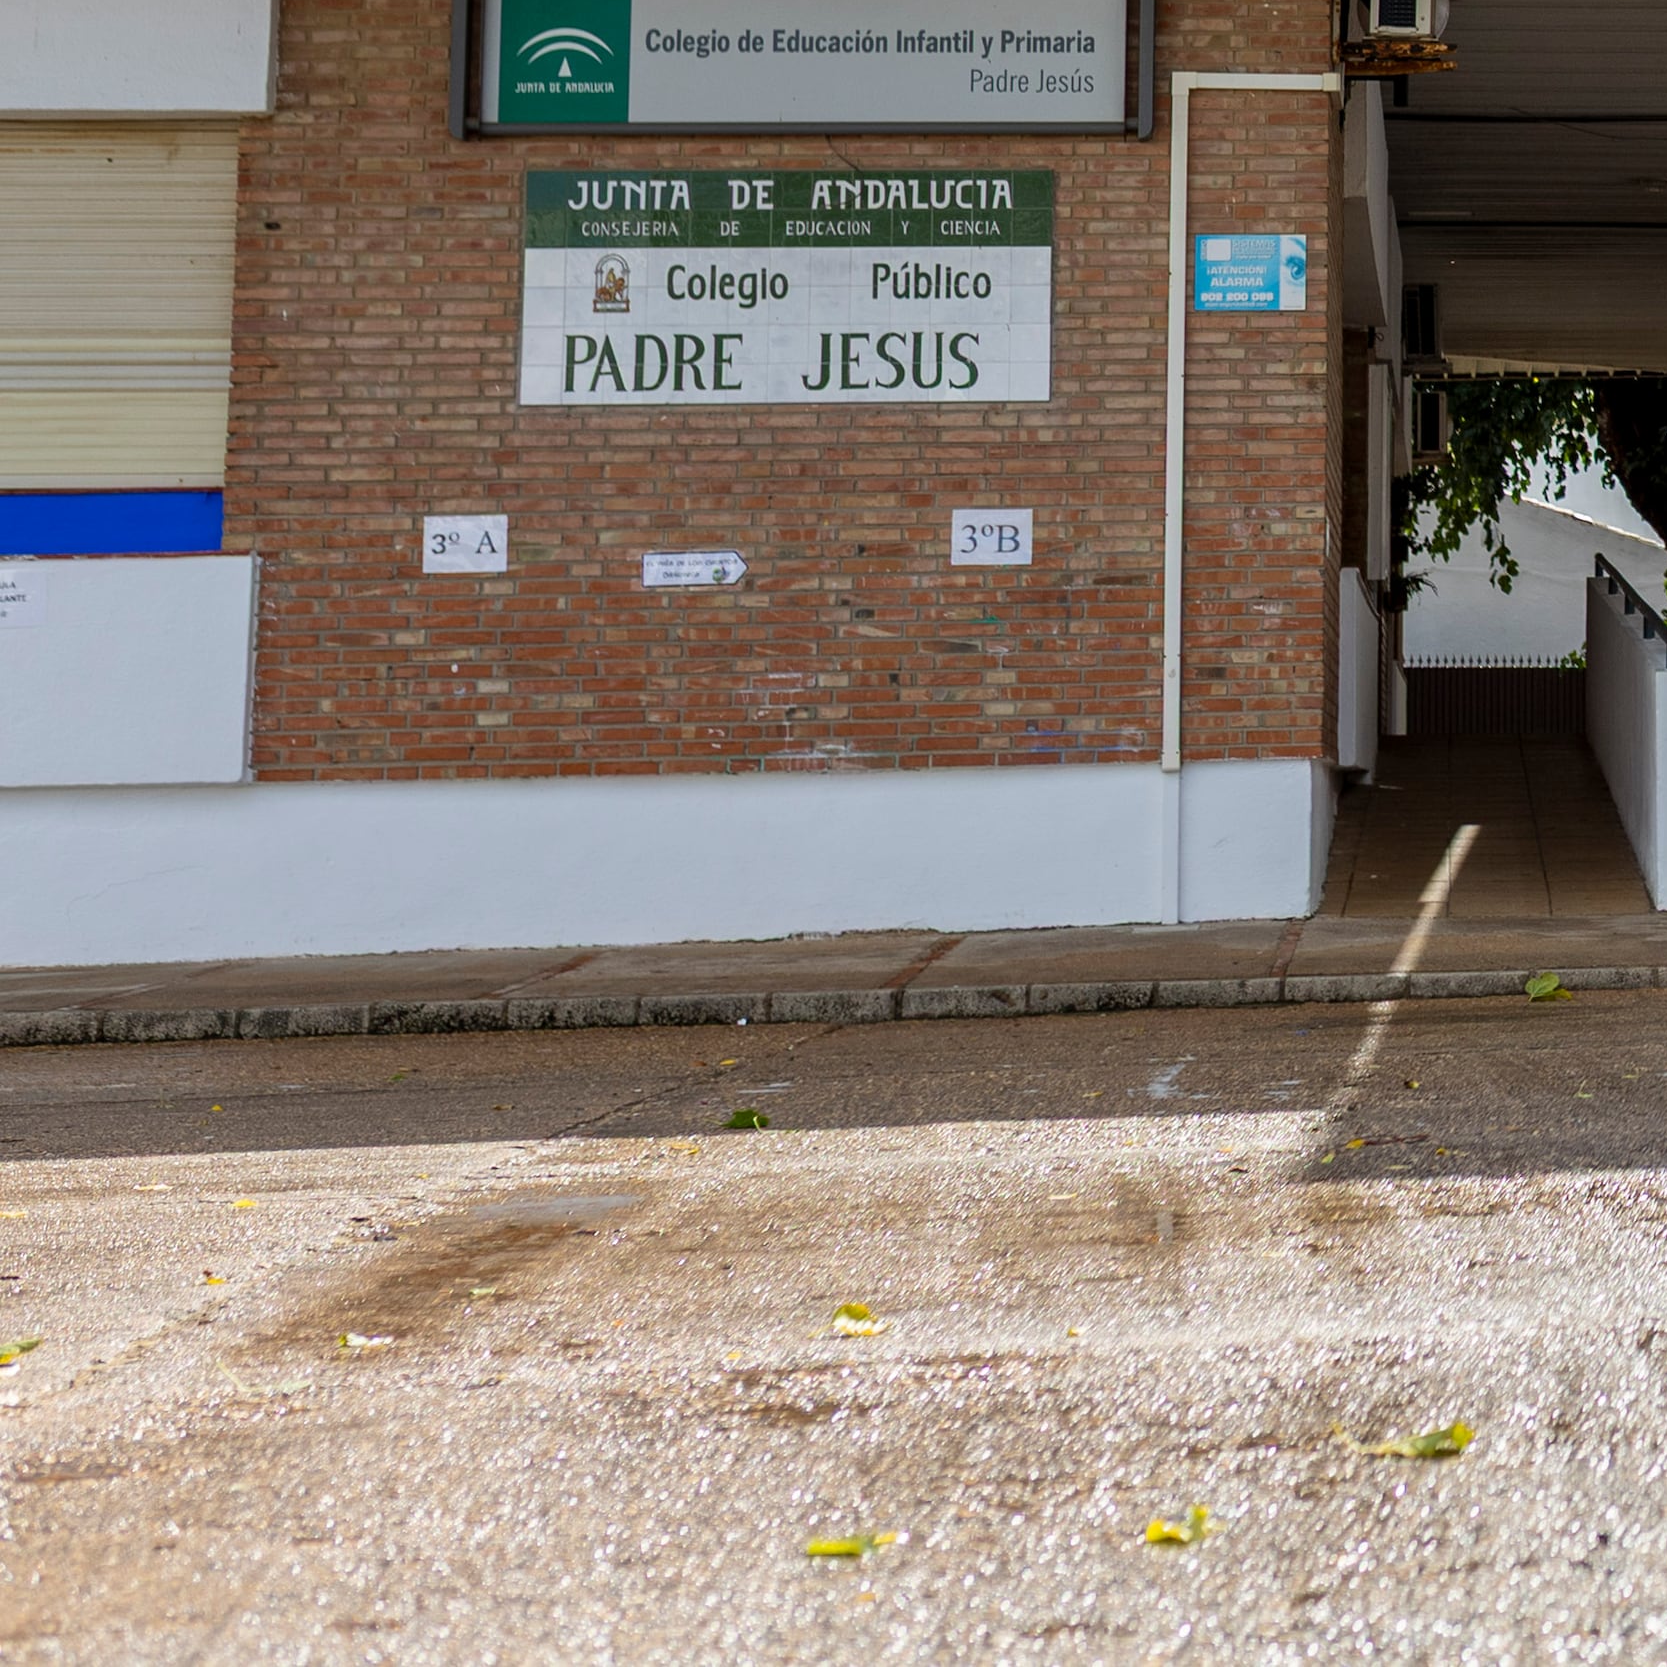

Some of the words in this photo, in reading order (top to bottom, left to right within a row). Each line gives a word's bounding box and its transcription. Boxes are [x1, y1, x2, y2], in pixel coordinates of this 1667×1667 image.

[646, 28, 730, 59] Colegio
[737, 29, 764, 53] de
[772, 29, 888, 53] Educación
[896, 29, 974, 54] Infantil
[981, 36, 994, 59] y
[1000, 29, 1095, 54] Primaria
[515, 82, 546, 94] JUNTA
[549, 82, 561, 94] DE
[565, 82, 615, 94] ANDALUCIA
[970, 68, 1029, 93] Padre
[1035, 68, 1094, 94] Jesús
[568, 180, 691, 210] JUNTA
[728, 180, 774, 210] DE
[811, 180, 1012, 210] ANDALUCIA
[581, 220, 679, 237] CONSEJERIA
[720, 220, 740, 237] DE
[785, 220, 871, 236] EDUCACION
[901, 220, 909, 235] Y
[940, 220, 1001, 236] CIENCIA
[667, 264, 789, 309] Colegio
[872, 261, 992, 300] Público
[1210, 277, 1264, 287] ALARMA
[564, 333, 743, 393] PADRE
[801, 331, 980, 391] JESUS
[431, 532, 460, 555] 3º
[475, 530, 498, 554] A
[960, 524, 1020, 554] 3ºB
